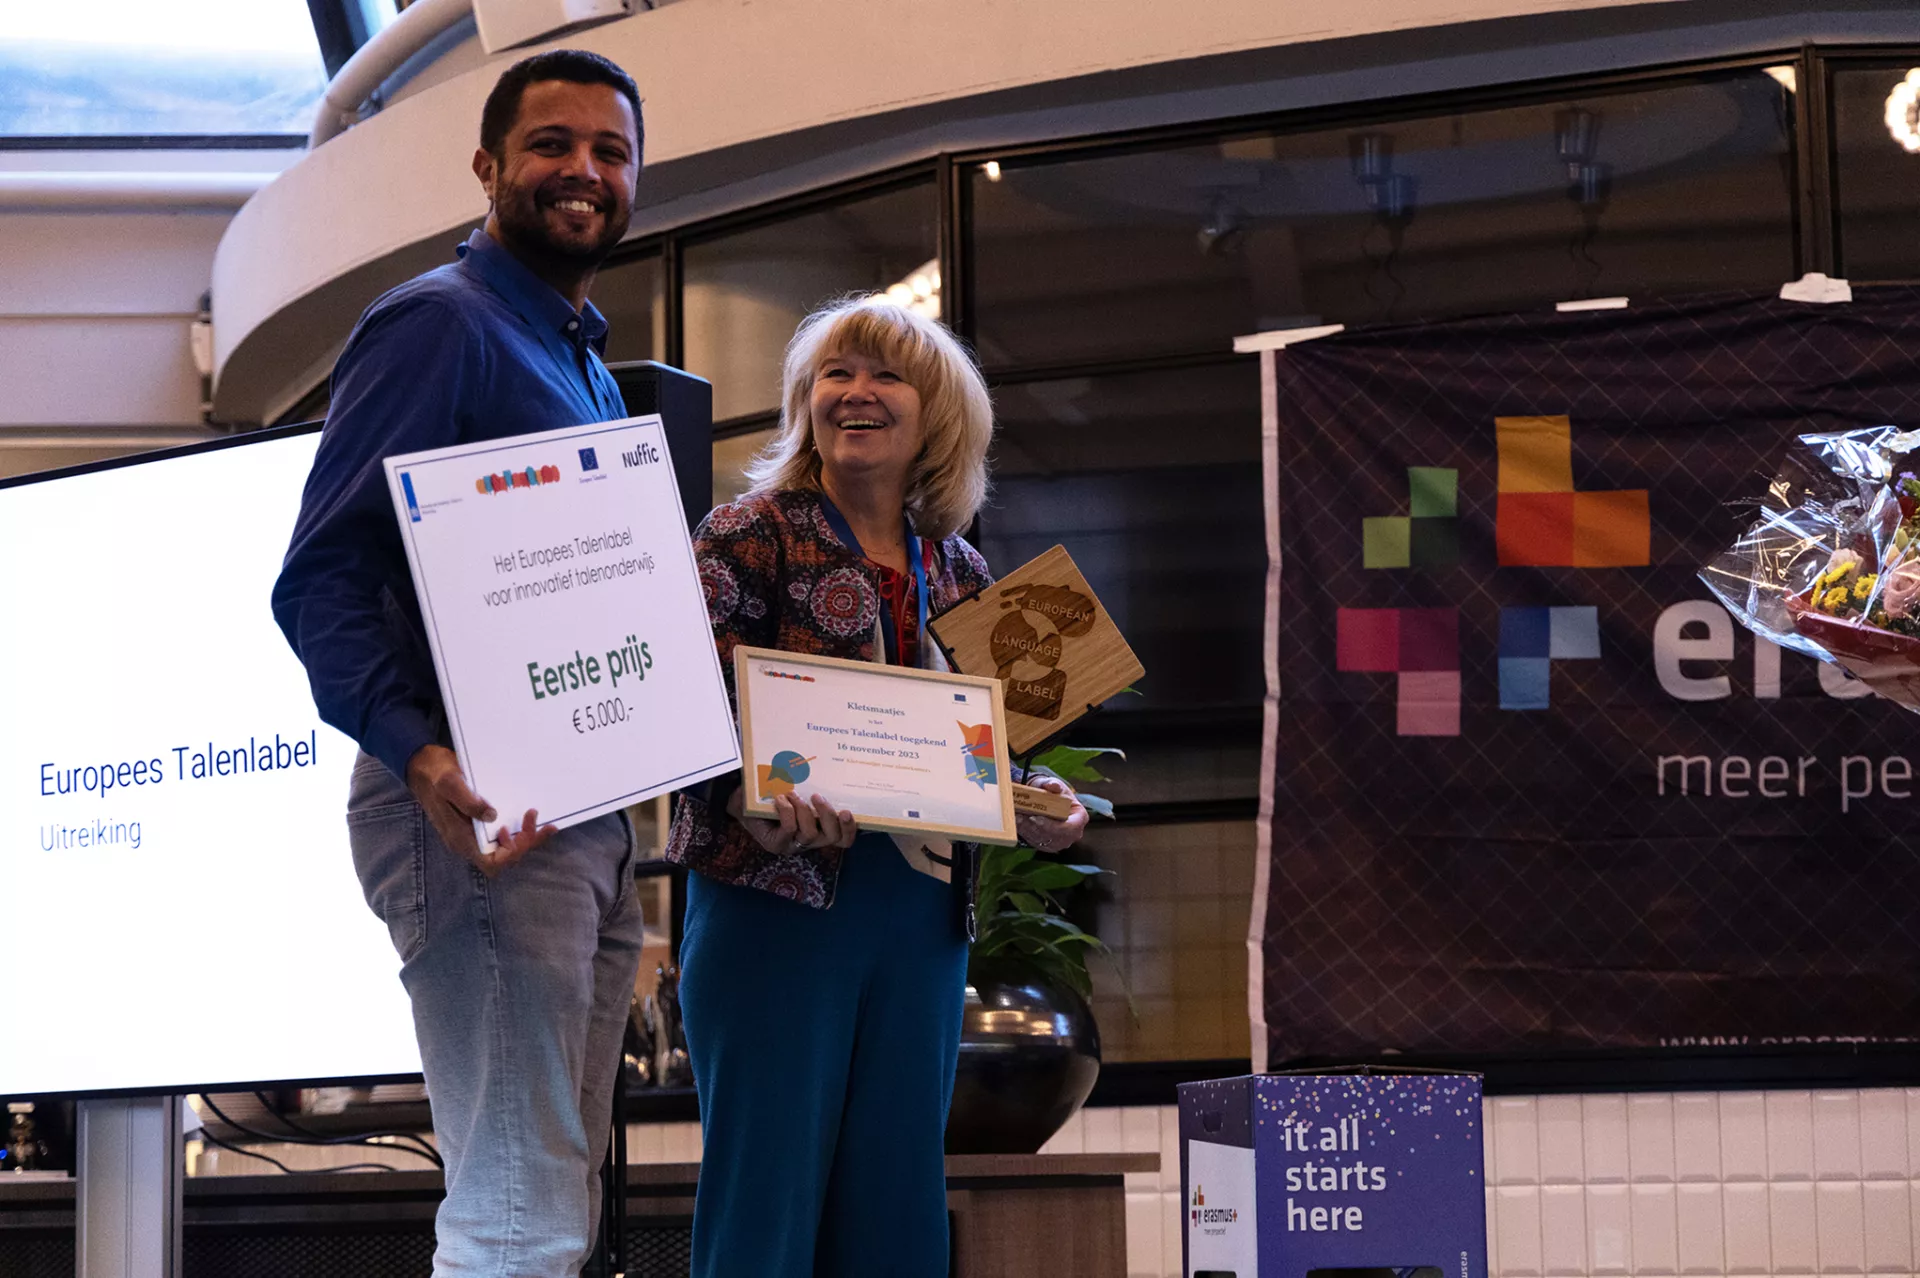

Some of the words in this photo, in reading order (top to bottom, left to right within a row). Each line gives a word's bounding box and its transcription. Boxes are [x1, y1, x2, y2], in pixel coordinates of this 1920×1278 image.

[622, 442, 660, 468] Nuffic
[493, 552, 516, 575] Het
[518, 541, 574, 569] Europees
[574, 527, 634, 556] Talenlabel
[483, 587, 512, 609] voor
[513, 571, 575, 601] innovatief
[575, 553, 655, 589] talenonderwijs
[1028, 599, 1090, 623] EUROPEAN
[993, 631, 1061, 659] LANGUAGE
[527, 650, 601, 700] Eerste
[606, 634, 653, 688] prijs
[1016, 681, 1057, 701] LABEL
[572, 709, 585, 734] €
[586, 697, 634, 731] 5.000,-
[847, 701, 906, 717] Kletsmaatjes
[806, 722, 849, 735] Europees
[850, 728, 898, 741] Talenlabel
[900, 735, 947, 747] toegekend
[836, 742, 848, 751] 16
[849, 745, 896, 757] november
[898, 749, 920, 760] 2023
[40, 757, 164, 798] Europees
[171, 729, 317, 781] Talenlabel
[1657, 754, 1817, 798] meer
[1841, 754, 1913, 814] pe
[40, 818, 142, 852] Uitreiking
[1284, 1119, 1309, 1152] it
[1320, 1118, 1360, 1152] all
[1286, 1161, 1387, 1192] starts
[1287, 1198, 1363, 1232] here
